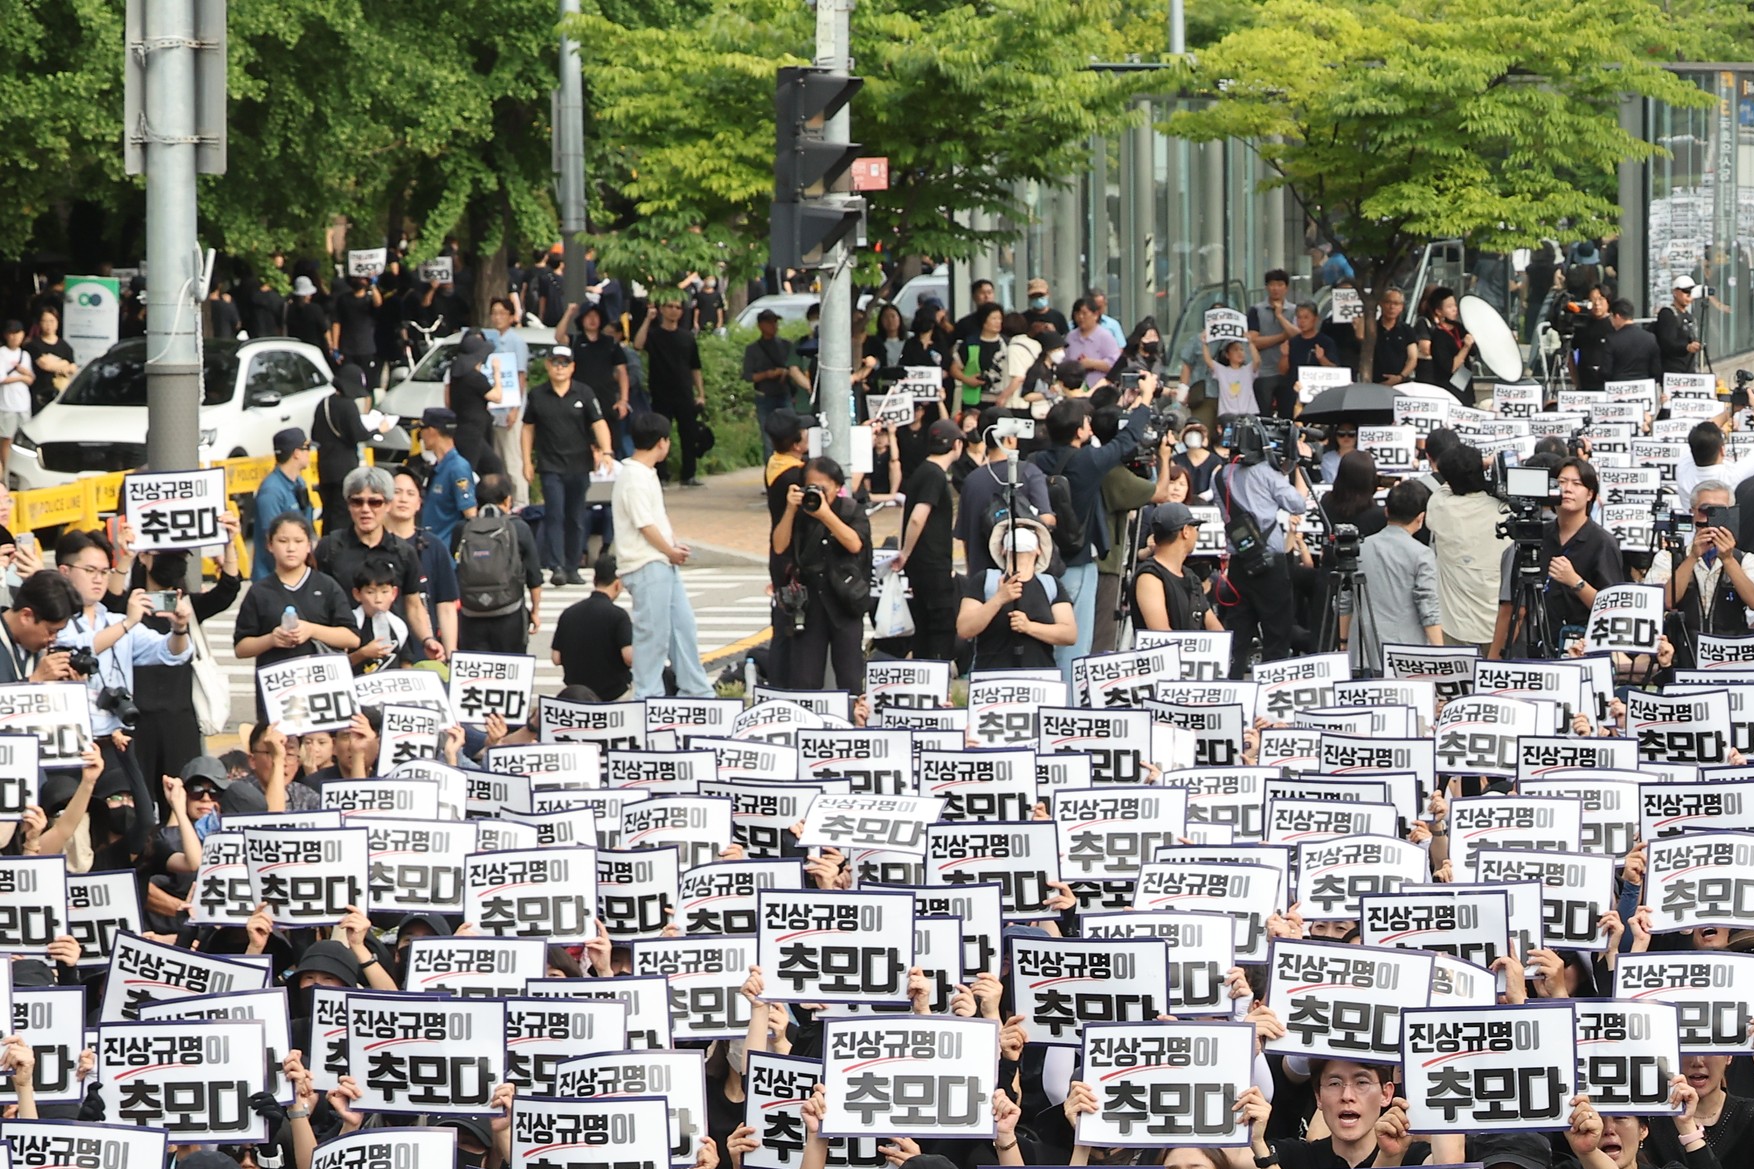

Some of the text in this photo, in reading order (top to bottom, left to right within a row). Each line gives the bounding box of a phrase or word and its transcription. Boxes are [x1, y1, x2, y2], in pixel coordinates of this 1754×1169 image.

[40, 497, 81, 514] POLICE LINE
[129, 479, 207, 501] 진상규명이
[141, 507, 217, 542] 추모다
[1593, 591, 1647, 611] 진상규명이
[1590, 618, 1659, 646] 추모다
[264, 661, 338, 687] 진상규명이
[455, 660, 519, 680] 진상규명이
[281, 689, 359, 724] 추모다
[460, 687, 525, 716] 추모다
[1630, 700, 1710, 724] 진상규명이
[1637, 730, 1726, 762] 추모다
[248, 839, 342, 864] 진상규명이
[1653, 843, 1754, 870] 진상규명이
[262, 876, 360, 916] 추모다
[1143, 872, 1249, 897] 진상규명이
[479, 897, 592, 936] 추모다
[766, 903, 883, 933] 진상규명이
[117, 944, 233, 994] 진상규명이
[414, 949, 516, 975] 진상규명이
[777, 944, 904, 994] 추모다
[1018, 951, 1135, 979] 진상규명이
[353, 1009, 472, 1042] 진상규명이
[1409, 1020, 1540, 1051] 진상규명이
[104, 1036, 229, 1067] 진상규명이
[832, 1030, 963, 1061] 진상규명이
[1090, 1037, 1218, 1067] 진상규명이
[367, 1053, 497, 1104] 추모다
[559, 1065, 671, 1097] 진상규명이
[120, 1081, 256, 1133] 추모다
[845, 1073, 985, 1127] 추모다
[1102, 1080, 1241, 1136] 추모다
[1426, 1066, 1570, 1123] 추모다
[516, 1112, 636, 1145] 진상규명이
